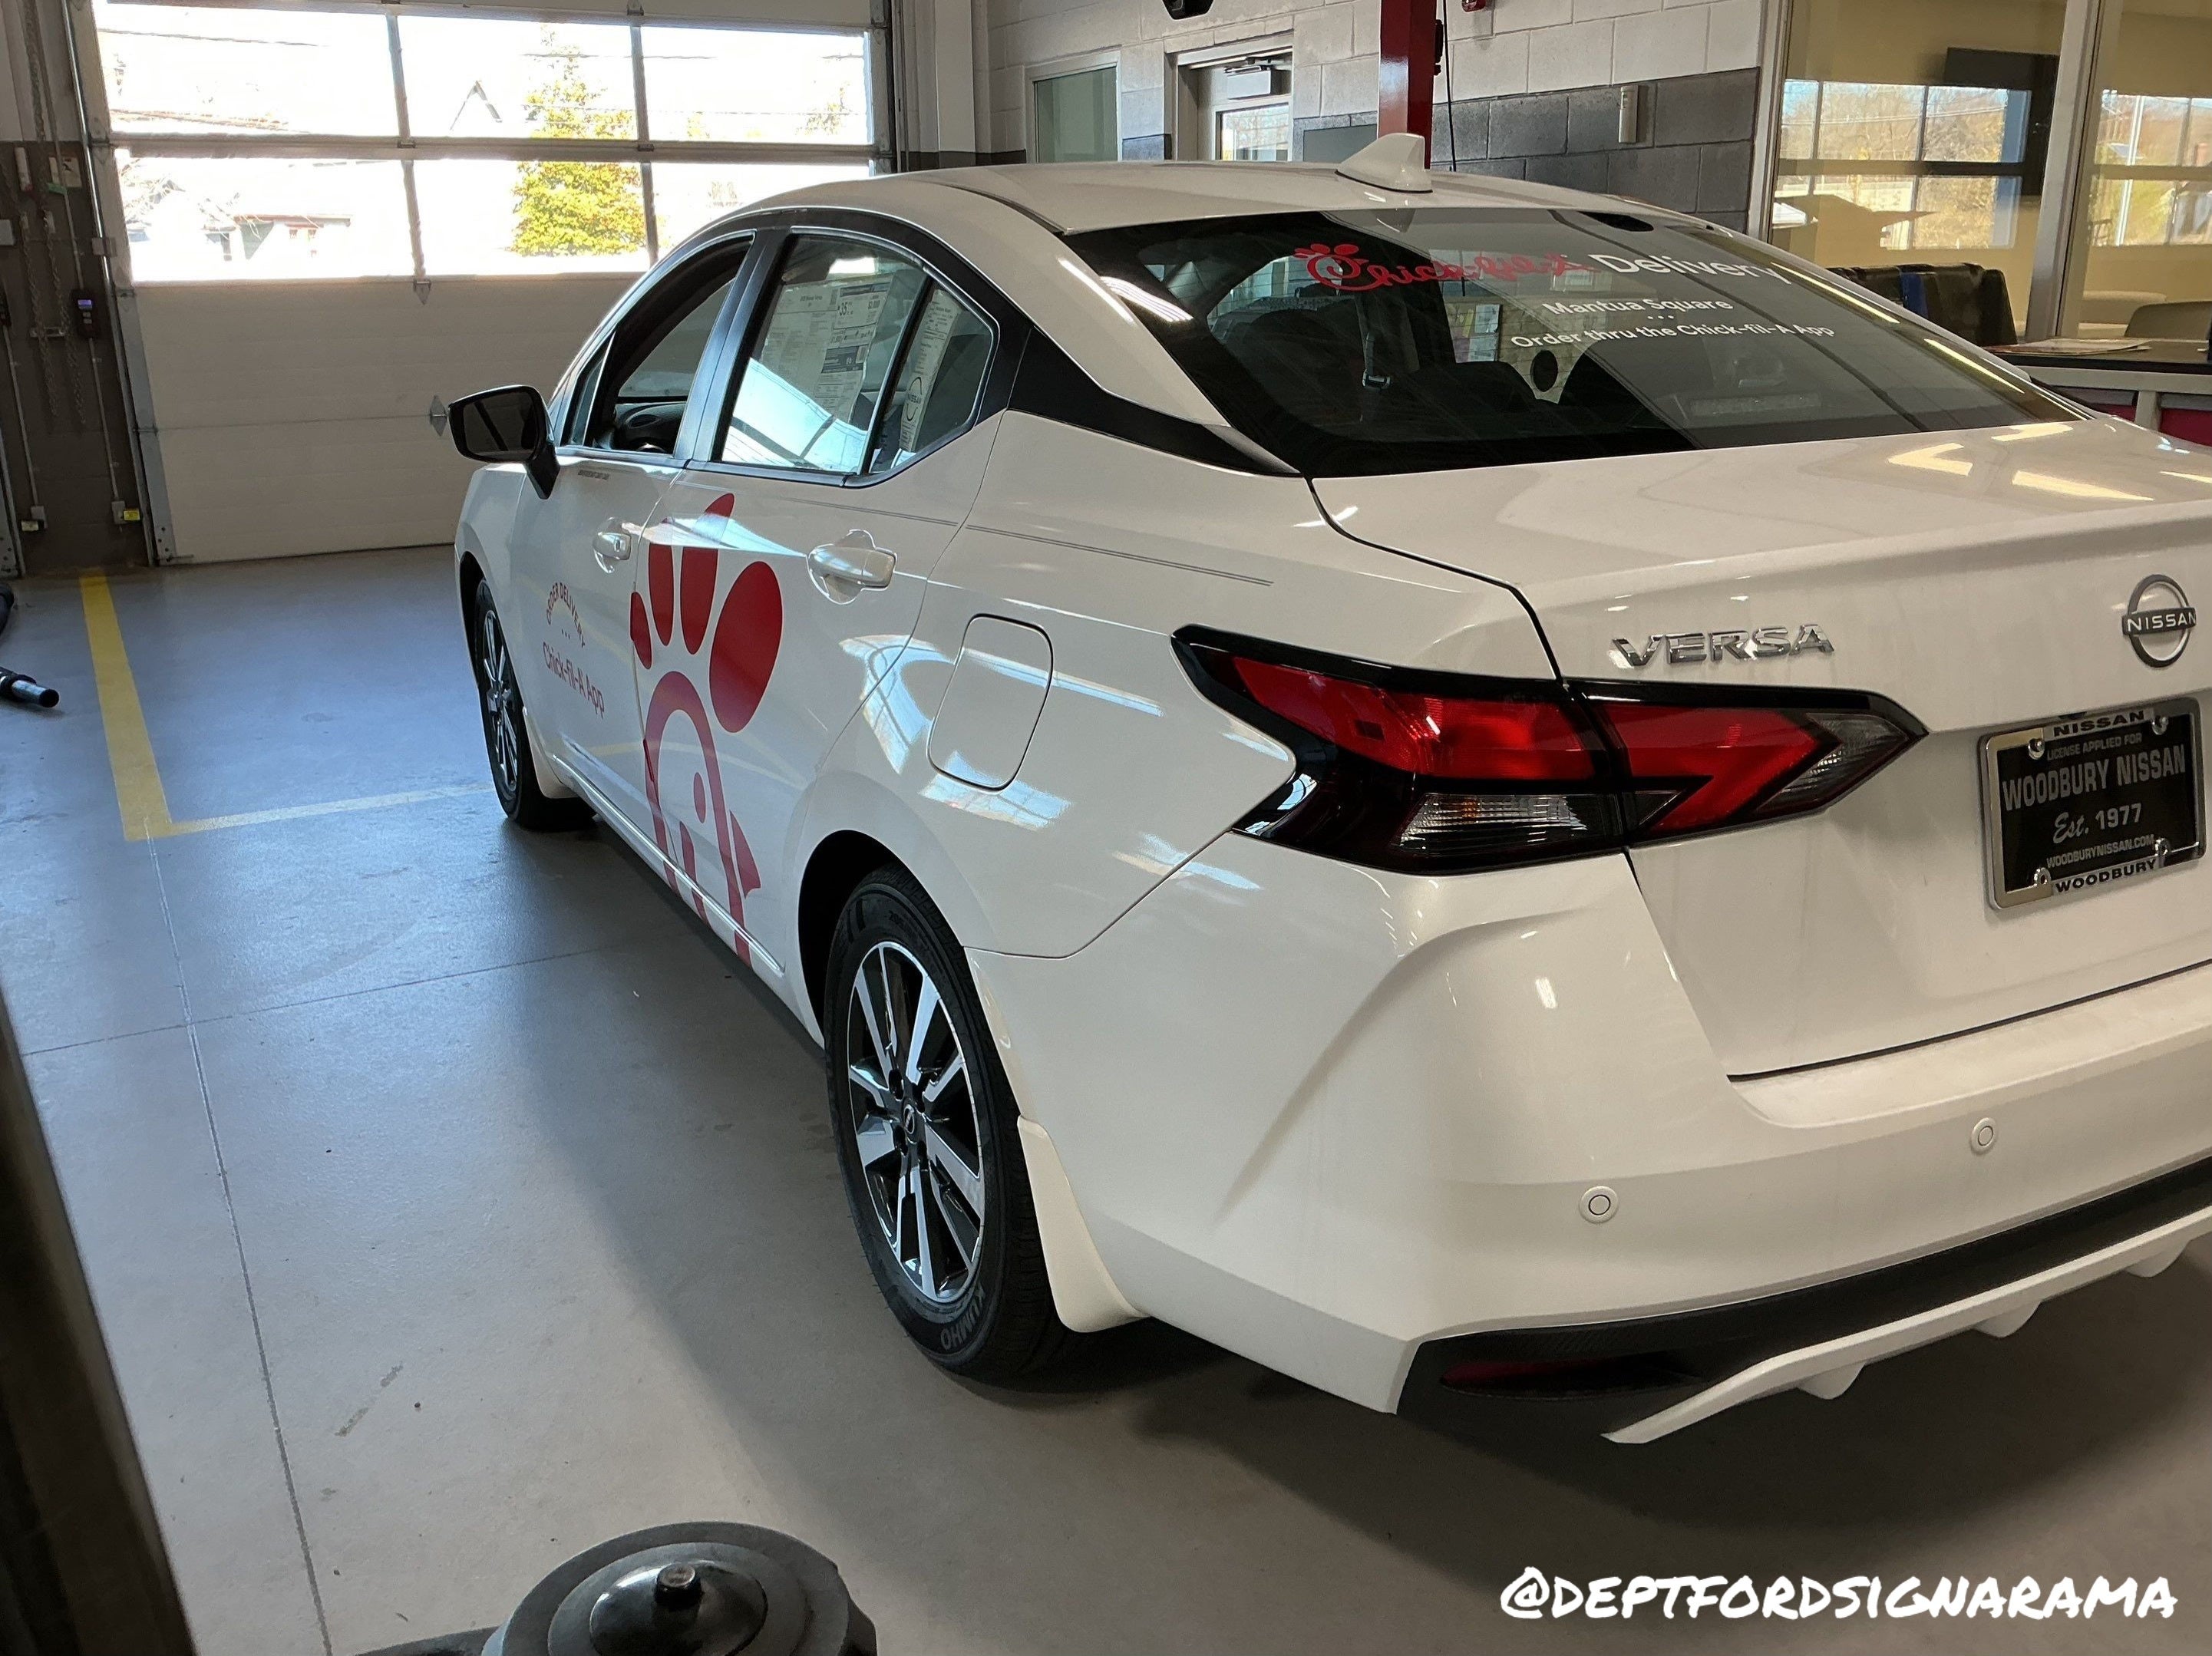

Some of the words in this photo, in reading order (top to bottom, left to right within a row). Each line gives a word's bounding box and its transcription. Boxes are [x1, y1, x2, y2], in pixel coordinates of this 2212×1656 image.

[1588, 254, 1792, 285] Delivery
[1542, 301, 1646, 315] Mantua
[1642, 299, 1733, 312] Square
[1511, 333, 1582, 348] Order
[1583, 330, 1639, 341] thru
[1635, 326, 1678, 338] the
[1676, 324, 1796, 335] Chick-fil-A
[1792, 324, 1835, 337] App
[546, 582, 559, 625] ORDER
[559, 582, 586, 648] DELIVERY
[2127, 612, 2196, 632] NISSAN
[1612, 623, 1835, 668] VERSA
[586, 674, 605, 720] App
[2053, 710, 2144, 737] NISSAN
[2047, 744, 2081, 761] LICENSE
[2082, 736, 2122, 754] APPLIED
[2124, 732, 2143, 745] FOR
[2002, 759, 2110, 811] WOODBURY
[2116, 744, 2186, 787] NISSAN
[2052, 811, 2089, 844] Est.
[2095, 803, 2142, 830] 1977
[2046, 833, 2154, 868] WOODBURYNISSAN.COM
[2055, 858, 2157, 892] WOODBURY
